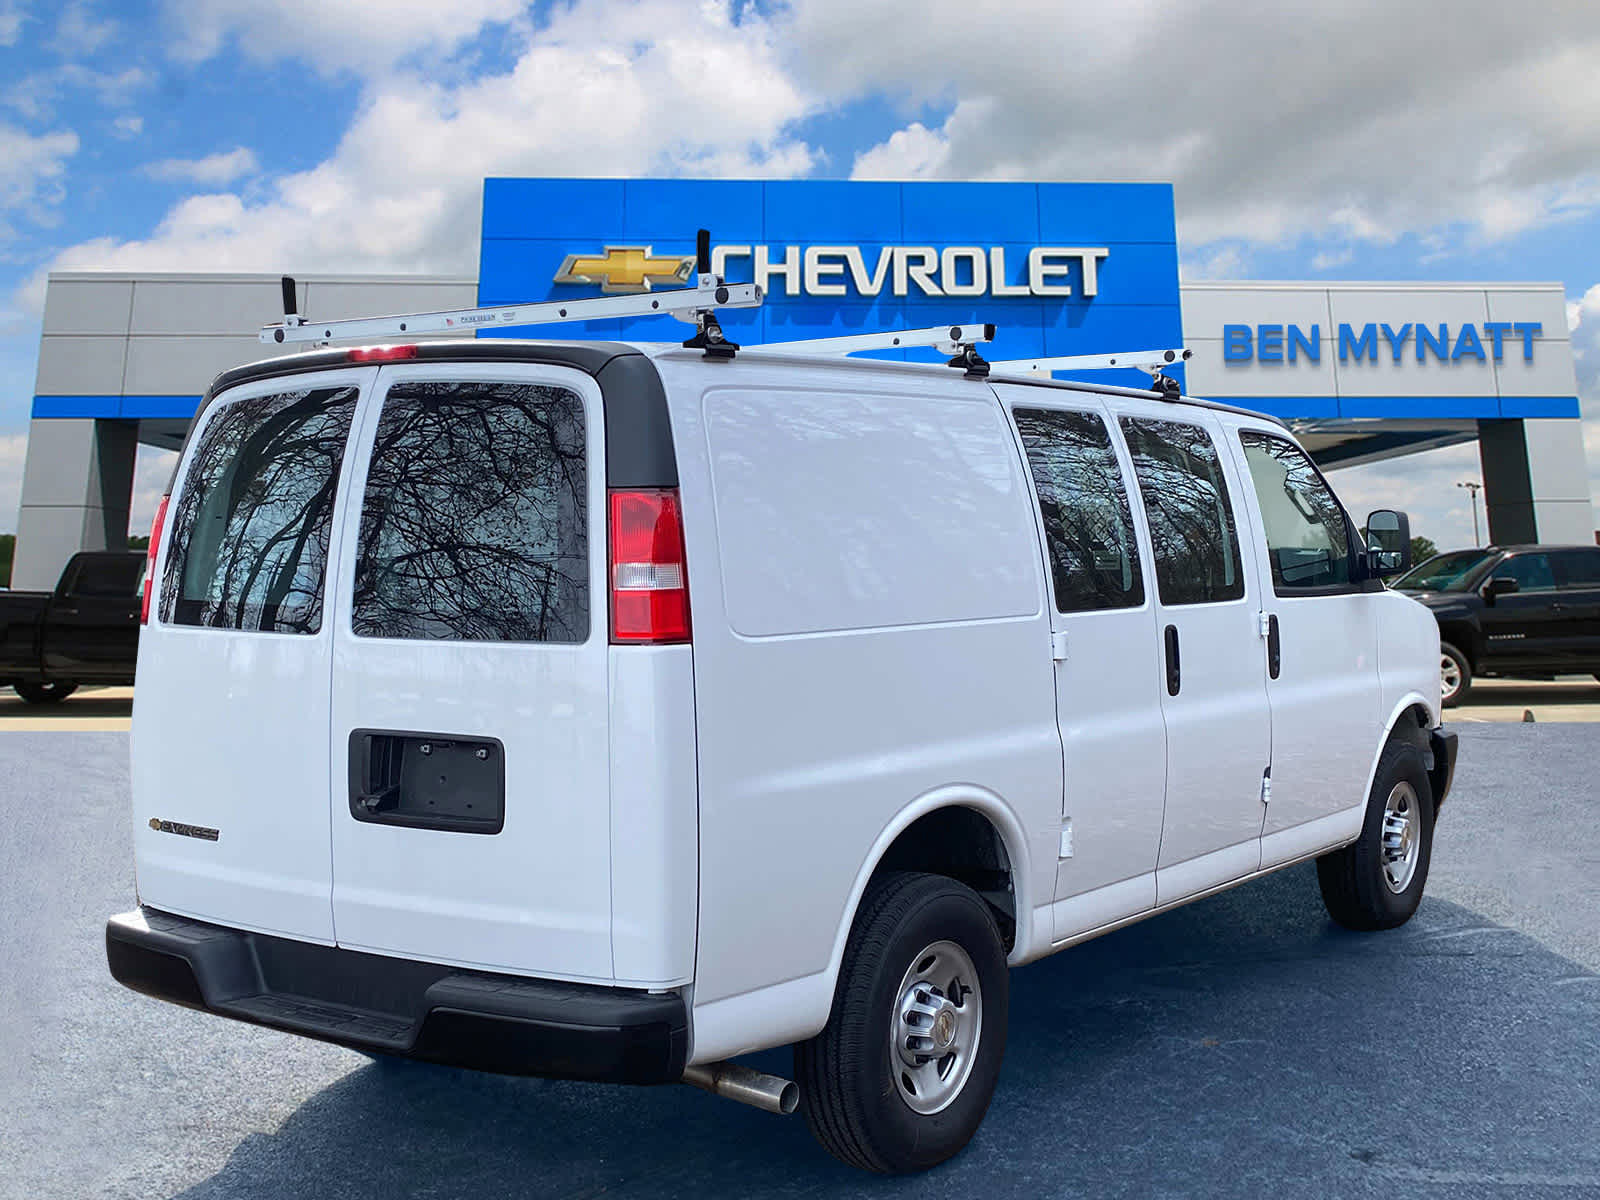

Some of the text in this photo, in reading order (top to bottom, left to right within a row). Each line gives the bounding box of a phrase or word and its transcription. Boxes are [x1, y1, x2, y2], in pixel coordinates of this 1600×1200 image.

[711, 245, 1110, 296] CHEVROLET
[1224, 322, 1543, 362] BEN MYNATT
[160, 820, 219, 842] EXPRESS
